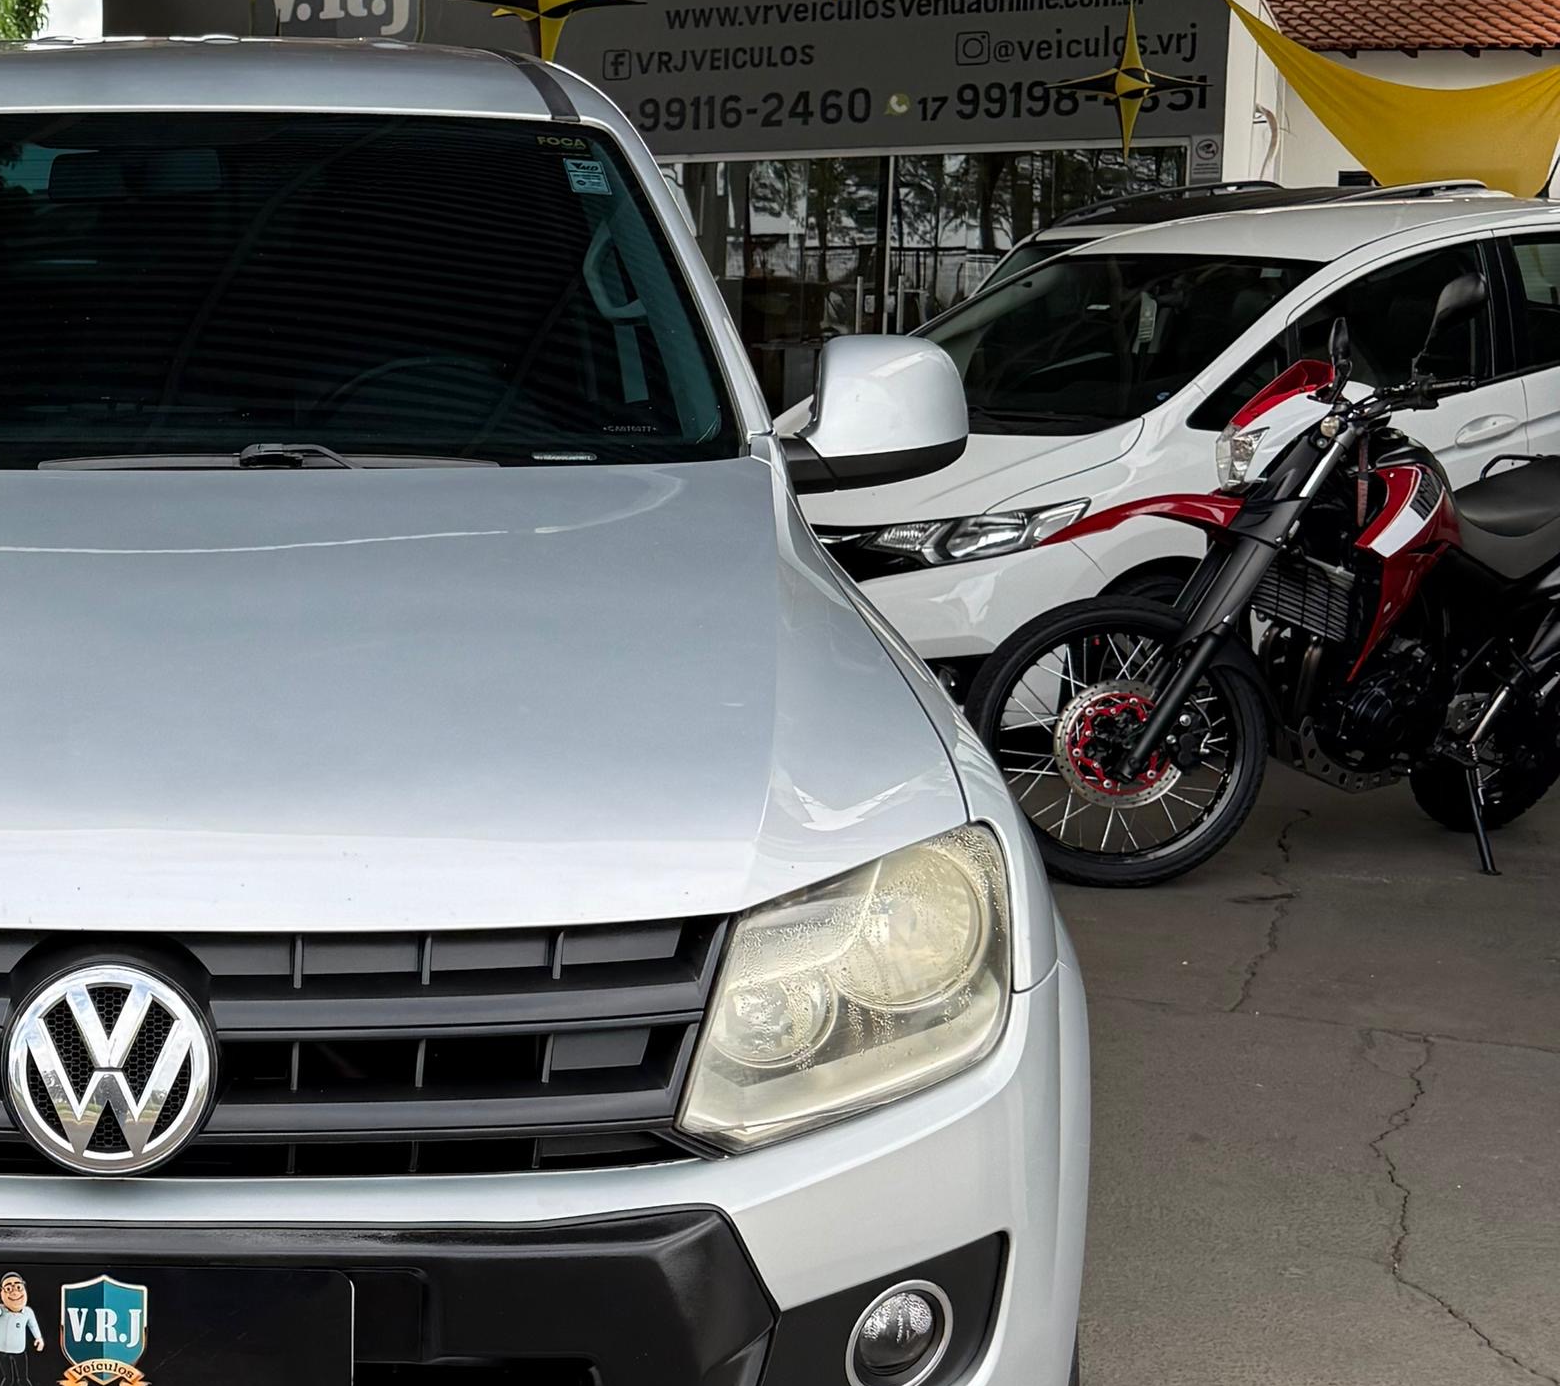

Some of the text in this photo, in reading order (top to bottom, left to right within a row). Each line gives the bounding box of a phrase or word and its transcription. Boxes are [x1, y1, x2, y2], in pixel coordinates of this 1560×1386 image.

[636, 44, 815, 75] VRJVEICULOS
[639, 87, 872, 133] 99116-2460
[916, 73, 1208, 121] 17 99198-51
[66, 1307, 143, 1348] V.R.J
